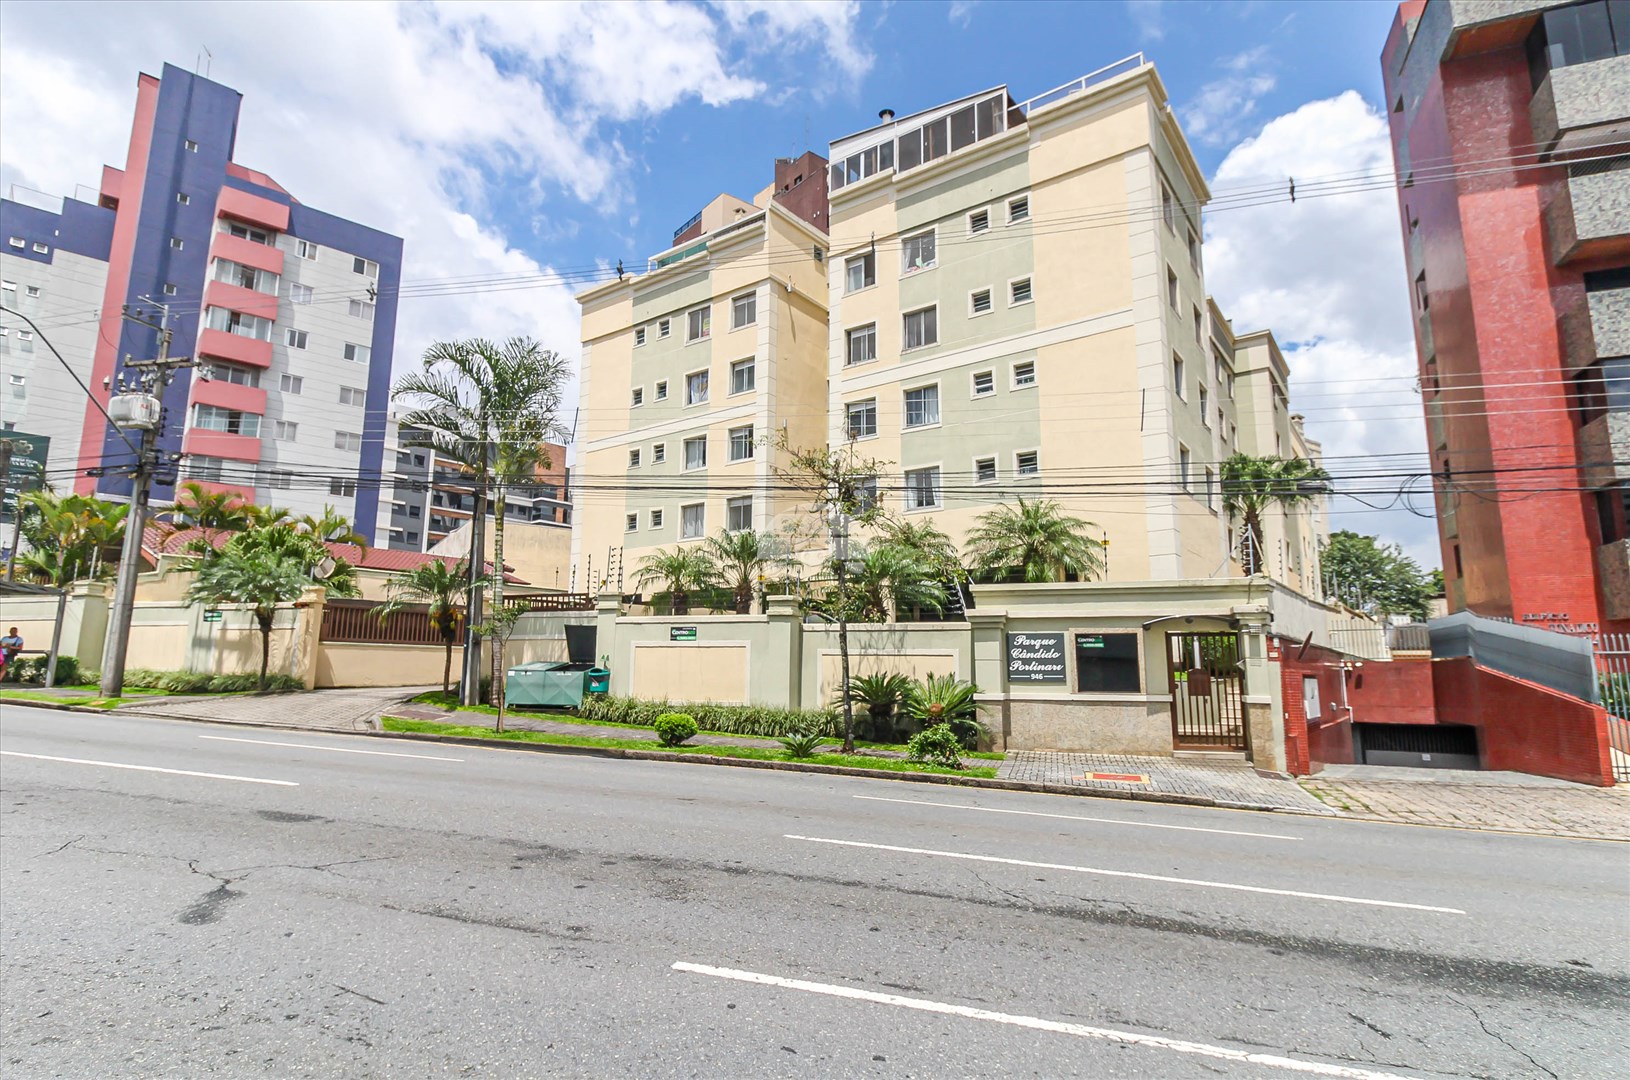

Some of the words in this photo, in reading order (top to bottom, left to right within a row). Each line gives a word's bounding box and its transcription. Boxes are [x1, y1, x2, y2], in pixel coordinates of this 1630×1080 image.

[1014, 635, 1057, 649] Parque
[1010, 648, 1061, 658] Cândido
[1009, 660, 1064, 670] Portinari
